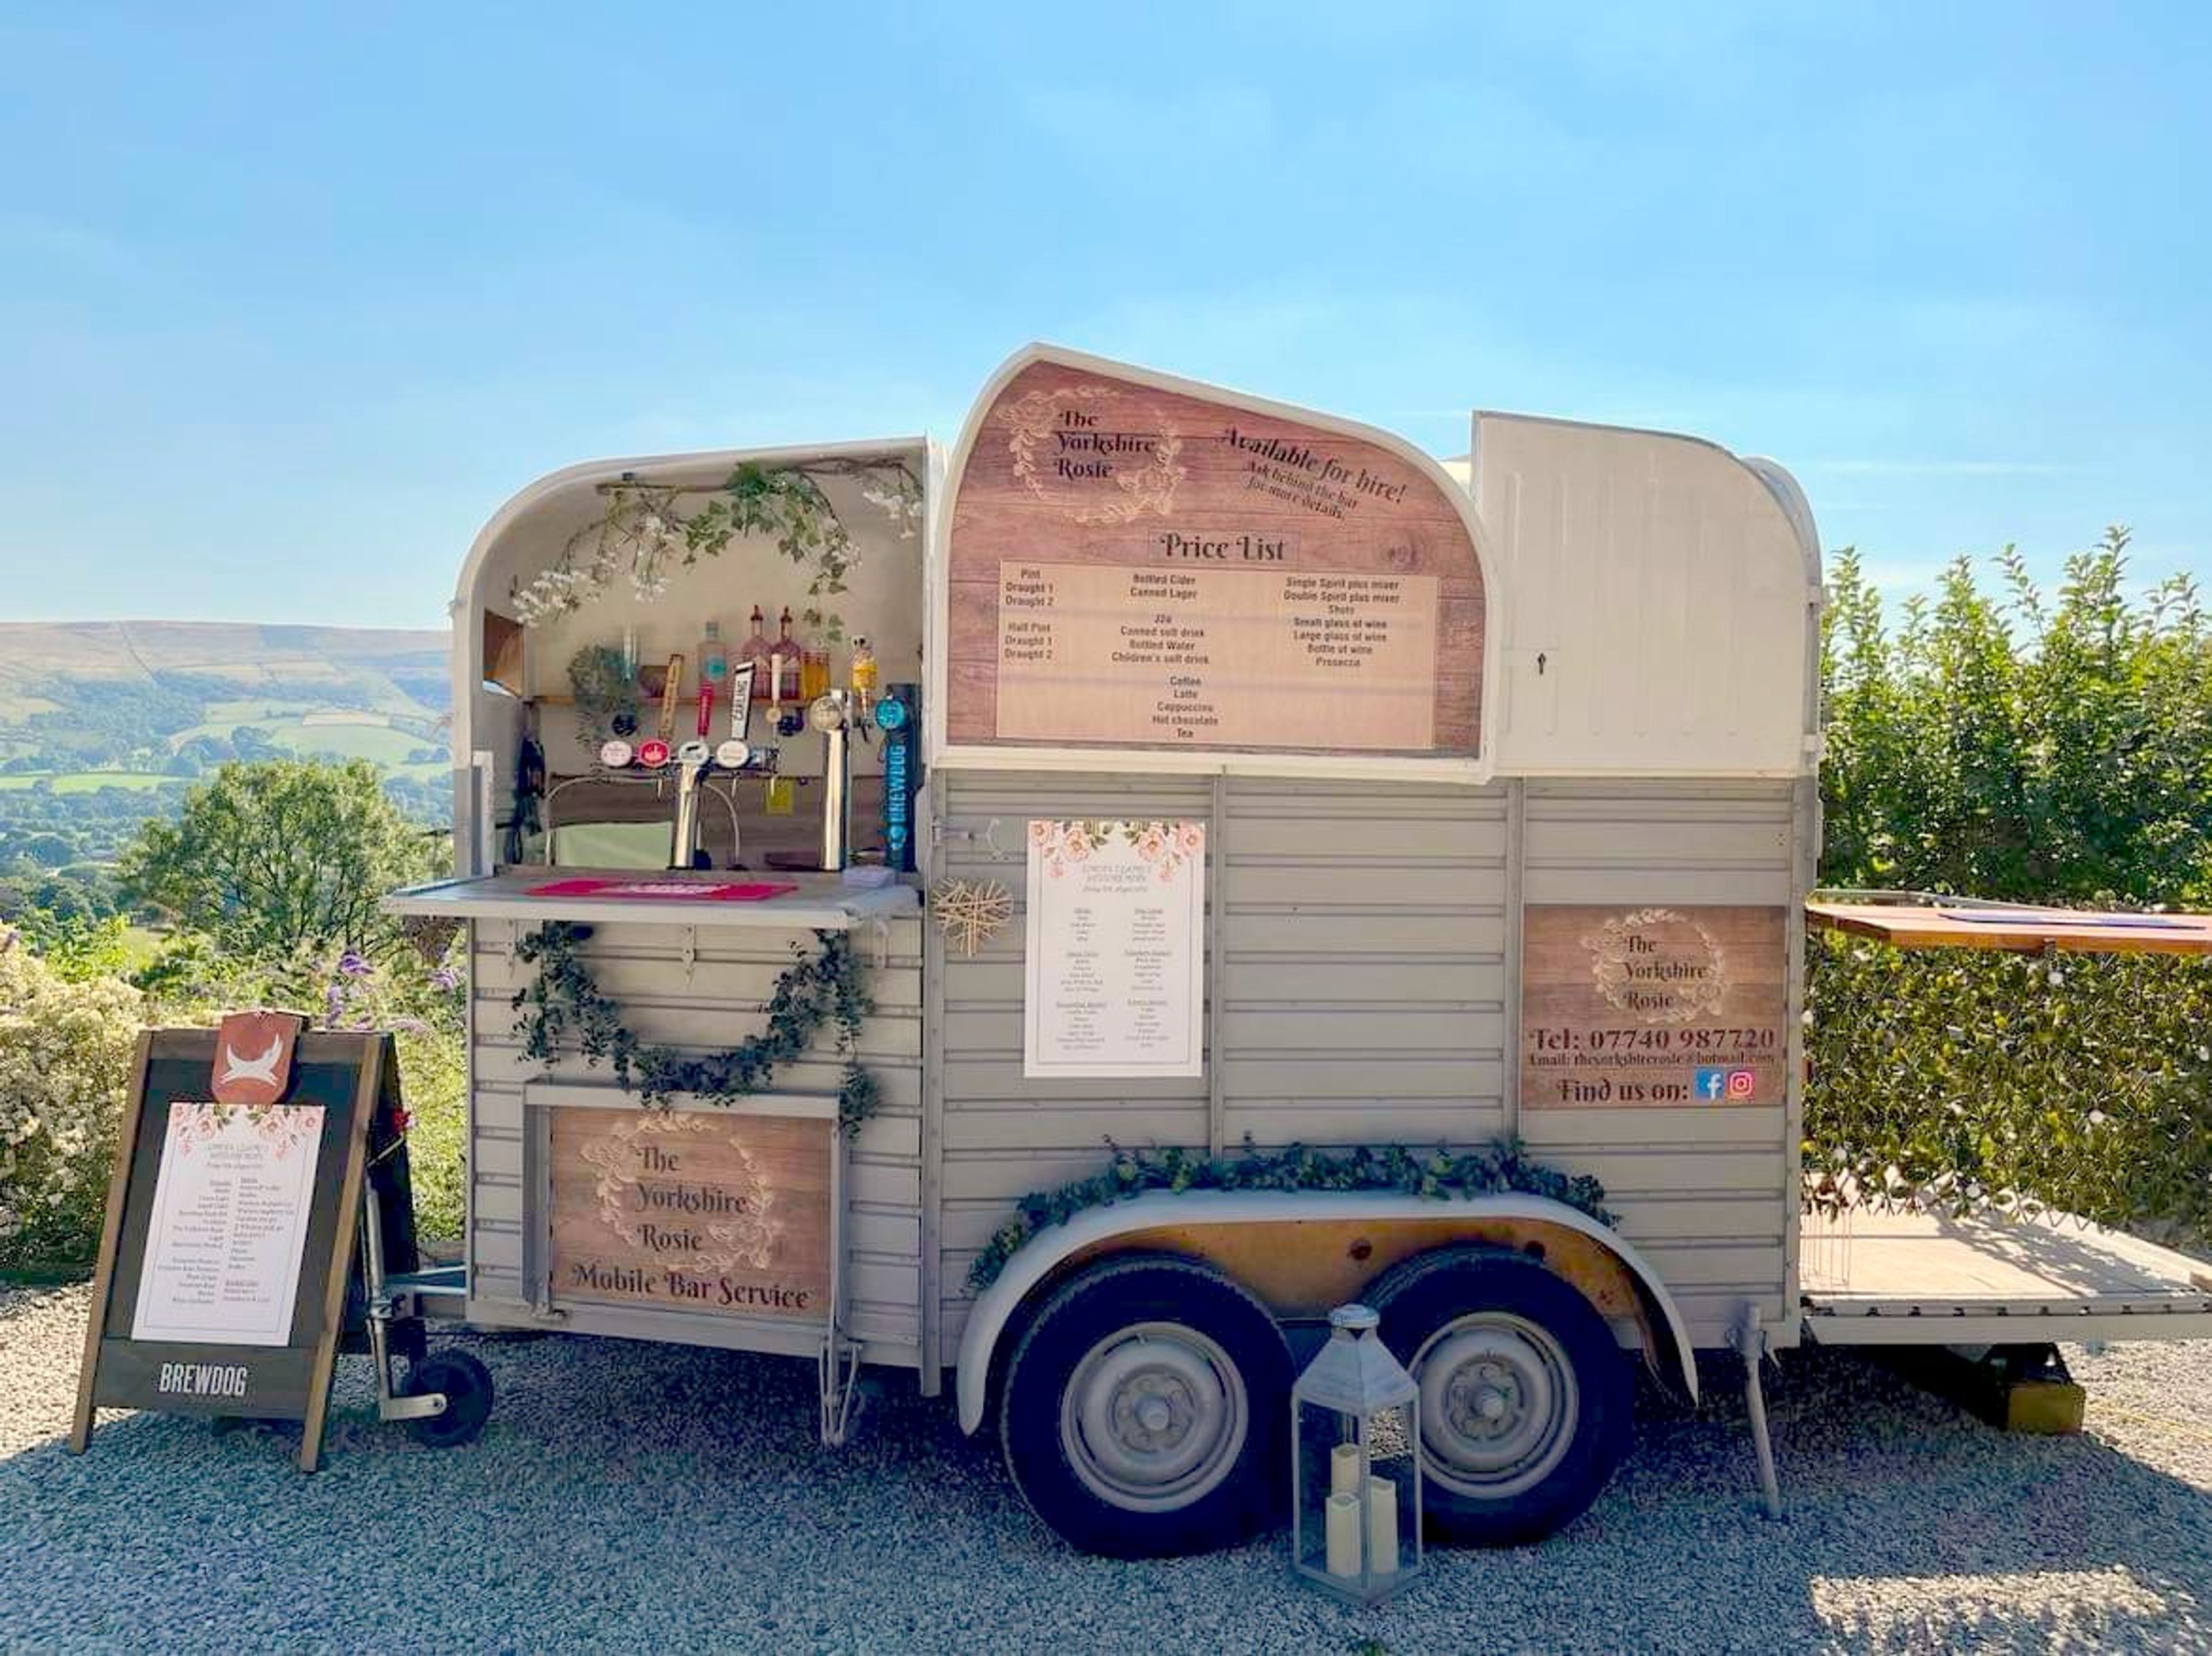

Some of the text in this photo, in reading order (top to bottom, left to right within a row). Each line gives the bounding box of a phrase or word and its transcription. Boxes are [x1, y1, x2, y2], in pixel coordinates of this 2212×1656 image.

[1059, 410, 1099, 427] The
[1058, 432, 1156, 454] Yorkshire
[1054, 458, 1113, 480] Rosie
[1225, 427, 1407, 504] Available for hire!
[1243, 461, 1358, 509] Ask behind the bar
[1246, 476, 1265, 491] for
[1268, 485, 1301, 503] more
[1160, 532, 1285, 560] Price List
[1021, 569, 1041, 579] Pint
[1132, 573, 1196, 585] Bottled Cider
[1006, 582, 1045, 594] Draught
[1286, 577, 1399, 590] Single Spirit plus mixer
[1130, 587, 1197, 600] Canned Lager
[1283, 590, 1400, 603] Double Spirit plus mixer
[1006, 595, 1054, 608] Draught 2
[1328, 605, 1355, 615] Shots
[1008, 622, 1051, 632] Half Pint
[1293, 617, 1387, 629] Small glass of wine
[1120, 626, 1205, 638] Canned soft drink
[1293, 630, 1387, 642] Large glass of wine
[1005, 635, 1044, 646] Draught
[1129, 639, 1196, 651] Bottled Water
[1004, 648, 1052, 660] Draught 2
[1308, 643, 1373, 654] Bottle of wine
[1111, 651, 1210, 664] Children's soft drink
[1315, 657, 1361, 667] Prosecco
[1170, 676, 1202, 686] Coffee
[1173, 689, 1198, 699] Latte
[1152, 715, 1219, 726] Hot chocolate
[1176, 727, 1194, 738] Tea
[889, 745, 906, 823] BREWDOG
[1623, 935, 1657, 954] The
[1622, 961, 1707, 982] Yorkshire
[1622, 991, 1674, 1011] Rosie
[1529, 1028, 1774, 1050] Tel: 07740 987720
[1529, 1053, 1570, 1066] Email:
[1556, 1078, 1611, 1102] Find
[1619, 1084, 1645, 1101] us
[1652, 1084, 1687, 1101] on:
[637, 1146, 682, 1172] The
[636, 1183, 748, 1214] Yorkshire
[637, 1223, 703, 1252] Rosie
[574, 1263, 812, 1309] Mobile Bar Service
[158, 1362, 248, 1396] BREWDOG
